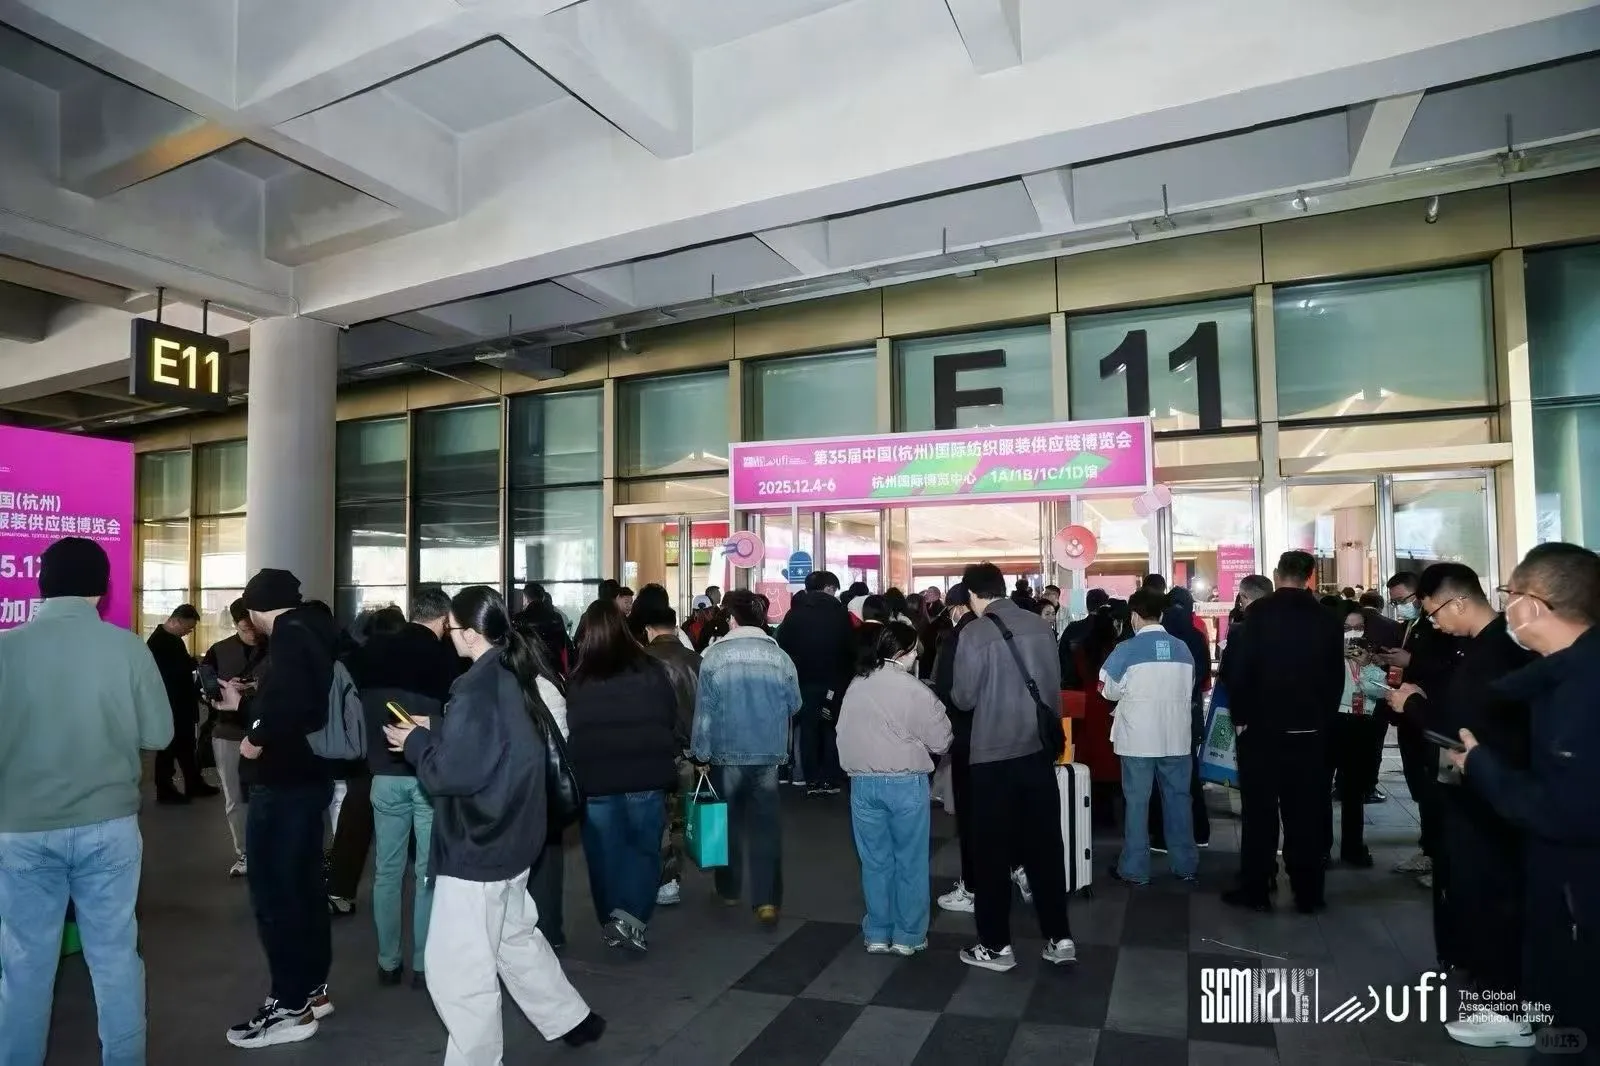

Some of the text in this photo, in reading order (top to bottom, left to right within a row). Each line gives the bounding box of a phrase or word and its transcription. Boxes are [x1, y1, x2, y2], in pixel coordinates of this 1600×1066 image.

[153, 337, 219, 393] E11
[813, 431, 1133, 465] 第35届中国(杭州)国际纺织服装供应链博览会
[758, 464, 1098, 495] 2025.12.4-6 杭州国际博览中心 1A/1B/1C/1D馆
[0, 554, 42, 578] 5.1
